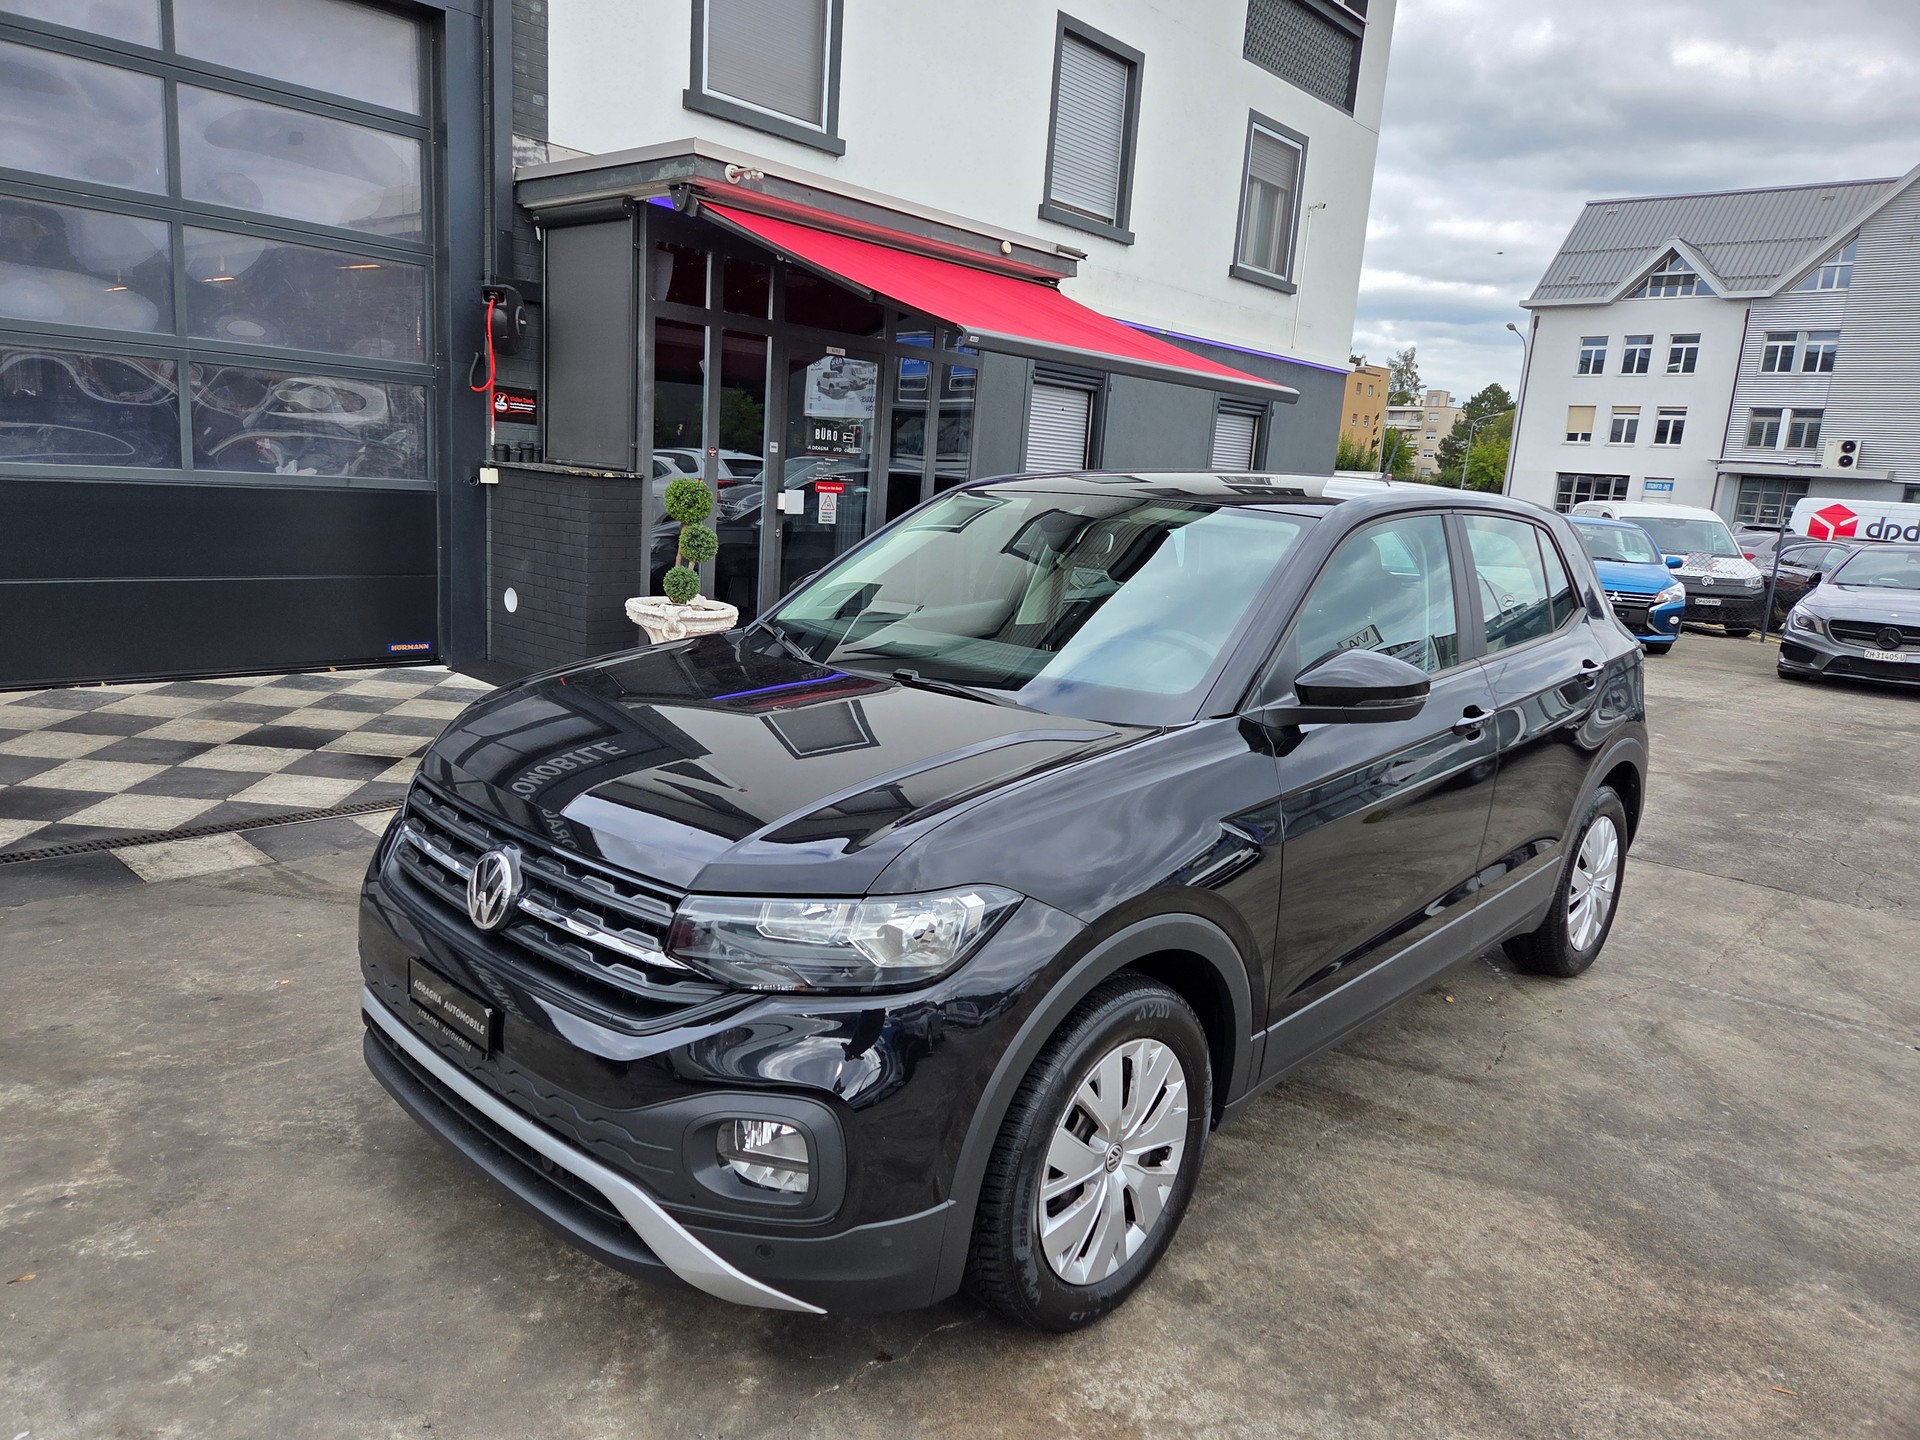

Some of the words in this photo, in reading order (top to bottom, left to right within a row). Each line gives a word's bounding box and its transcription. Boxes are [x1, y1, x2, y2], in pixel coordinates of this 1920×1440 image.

[815, 427, 838, 441] BÜRO
[1866, 516, 1920, 542] dpd
[413, 979, 442, 1006] ADRAGNA
[443, 1000, 486, 1035] AUTOMOBILE
